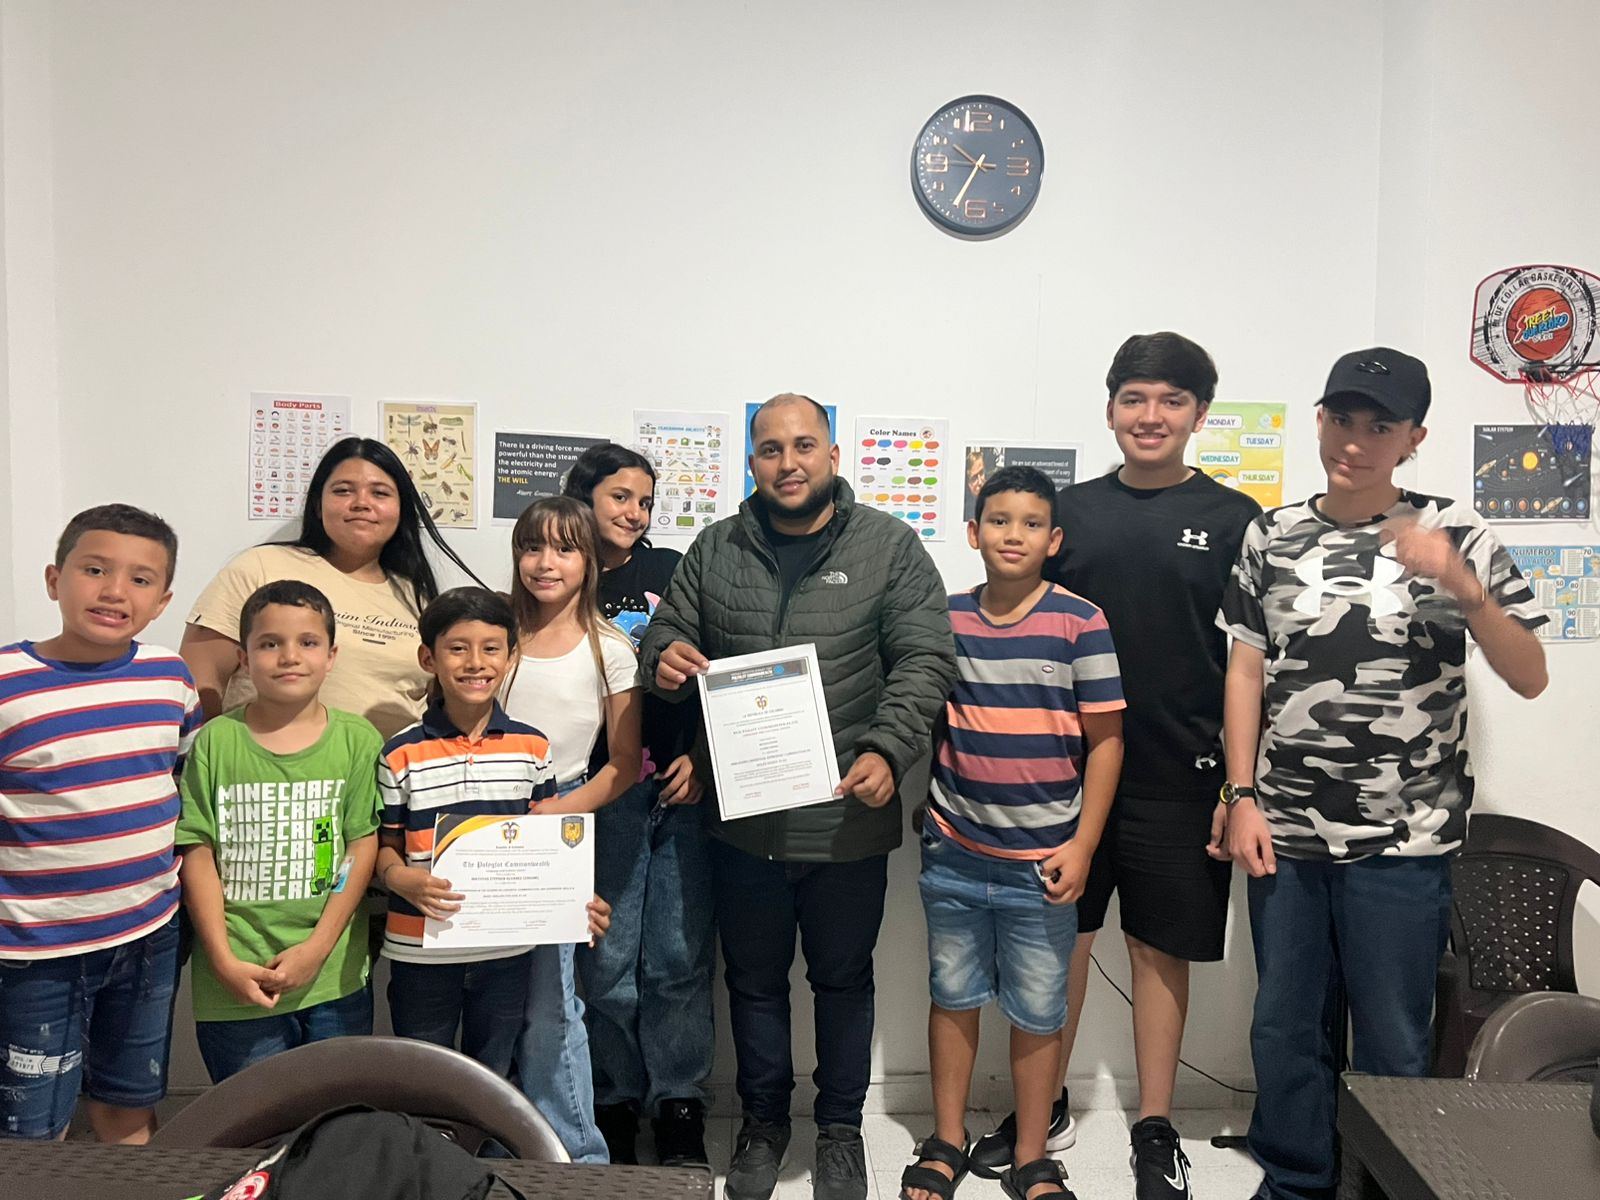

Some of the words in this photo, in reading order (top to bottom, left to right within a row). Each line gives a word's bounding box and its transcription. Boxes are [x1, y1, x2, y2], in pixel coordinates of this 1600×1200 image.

[964, 109, 992, 132] 12
[925, 152, 949, 173] 9
[1006, 156, 1030, 176] 3
[964, 199, 988, 219] 6
[1501, 277, 1530, 304] COLLAR
[1530, 271, 1580, 297] BASKETBALL
[275, 400, 298, 409] Body
[299, 401, 321, 410] Parts
[1207, 418, 1236, 426] MONDAY
[869, 428, 891, 437] Color
[892, 429, 917, 437] Names
[498, 440, 518, 449] There
[519, 442, 525, 450] is
[531, 442, 554, 452] driving
[555, 443, 573, 452] force
[1246, 437, 1274, 445] TUESDAY
[498, 450, 528, 458] powerful
[529, 451, 545, 459] than
[546, 451, 557, 460] the
[557, 453, 578, 461] steam
[1200, 455, 1240, 463] WEDNESDAY
[498, 458, 510, 466] the
[510, 459, 543, 468] electricity
[497, 467, 509, 475] the
[510, 467, 533, 476] atomic
[497, 475, 511, 484] THE
[511, 476, 529, 484] WILL
[1241, 474, 1275, 482] THURSDAY
[352, 628, 376, 637] Since
[362, 625, 415, 638] Manufacturing
[218, 778, 346, 804] MINECRAFT
[218, 797, 341, 824] MINECRAFT
[219, 815, 339, 842] MINECRT
[220, 834, 340, 862] MINECRT
[220, 854, 339, 881] MINECRT
